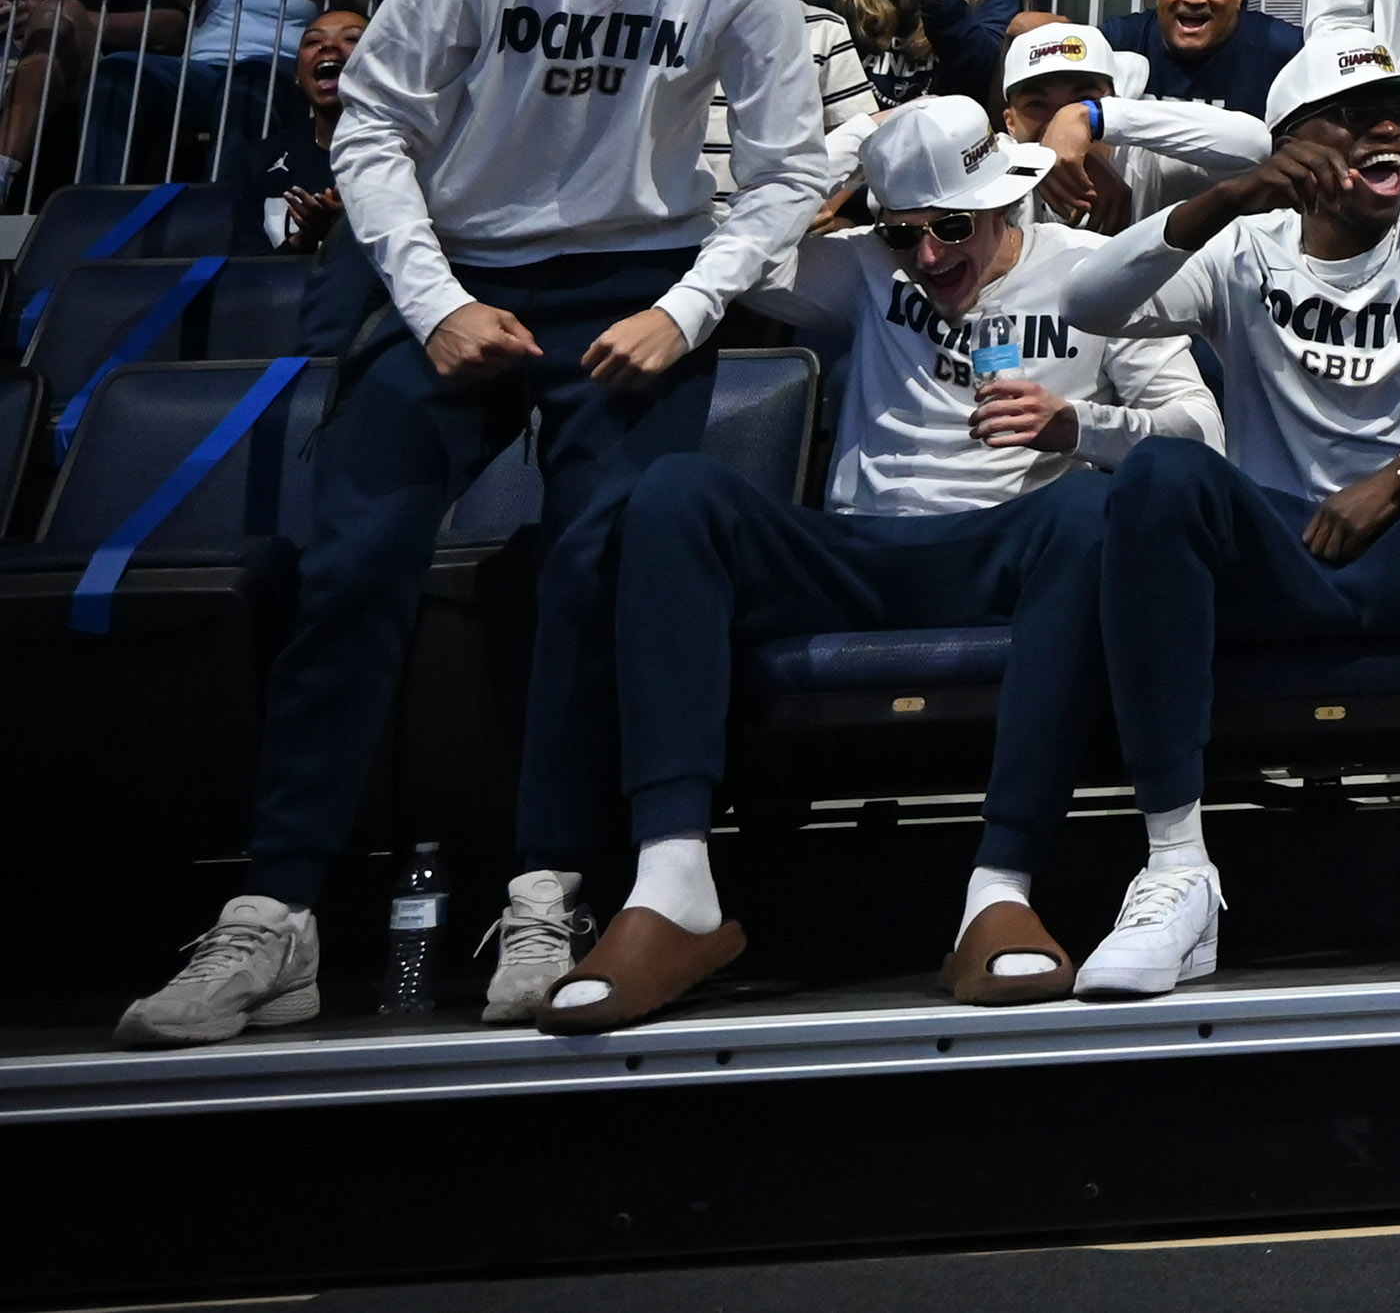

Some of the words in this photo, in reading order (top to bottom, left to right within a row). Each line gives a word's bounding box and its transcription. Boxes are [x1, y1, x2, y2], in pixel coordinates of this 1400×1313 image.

[603, 12, 653, 60] IT
[542, 63, 627, 97] CBU
[1022, 314, 1079, 359] IN.
[1354, 302, 1393, 349] IT
[935, 352, 972, 388] CB
[1301, 349, 1375, 382] CBU
